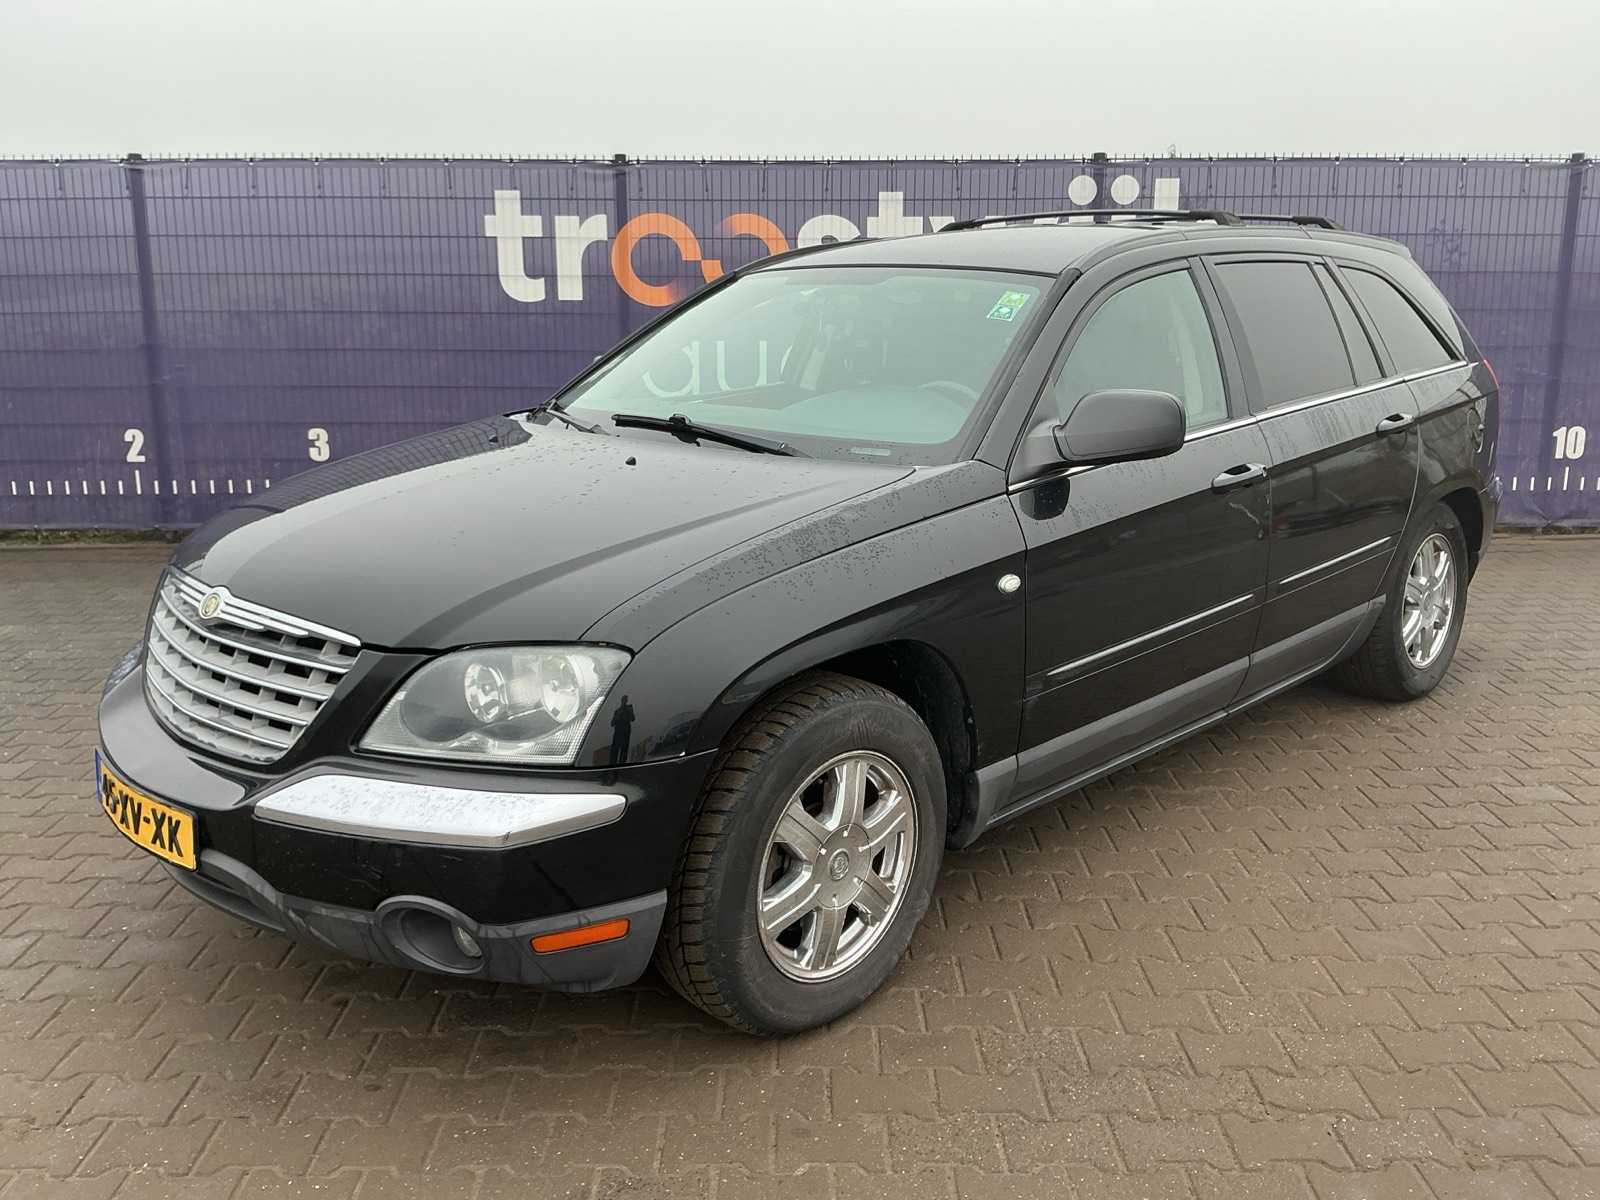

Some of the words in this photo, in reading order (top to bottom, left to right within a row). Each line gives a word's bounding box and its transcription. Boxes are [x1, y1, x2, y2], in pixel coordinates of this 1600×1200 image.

[484, 174, 1216, 307] troot
[124, 429, 146, 463] 2
[308, 428, 330, 462] 3
[1552, 426, 1586, 459] 10
